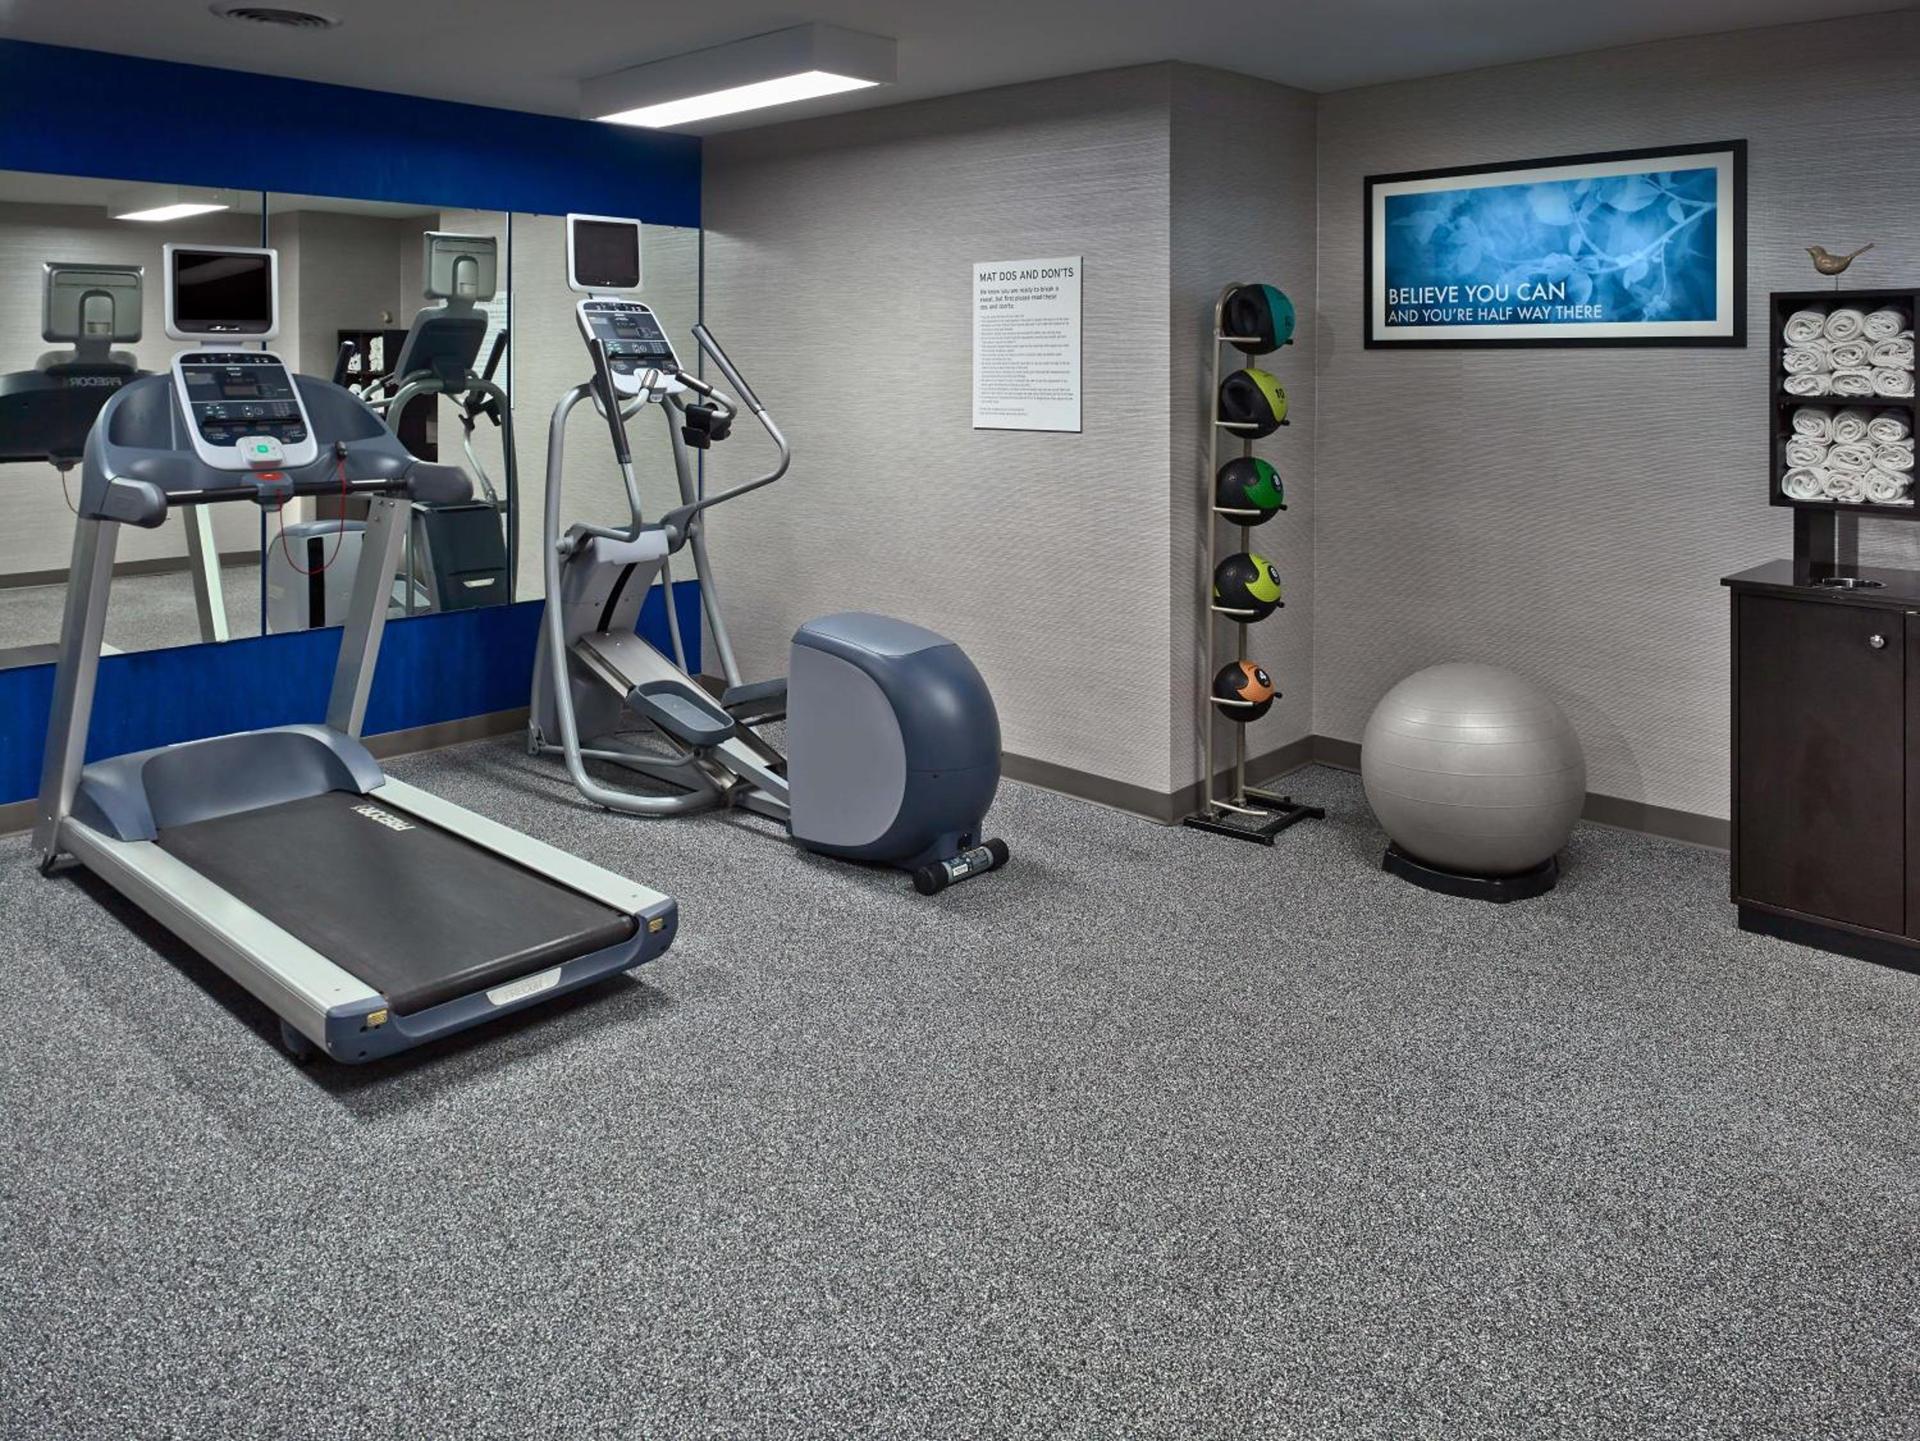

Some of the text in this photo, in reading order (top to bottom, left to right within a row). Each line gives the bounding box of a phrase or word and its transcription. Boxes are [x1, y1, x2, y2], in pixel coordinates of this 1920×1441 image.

[979, 267, 1074, 282] MAT DOS AND DON'TS
[1388, 281, 1566, 305] BELIEVE YOU CAN
[1387, 304, 1603, 323] AND YOU'RE HALF WAY THERE
